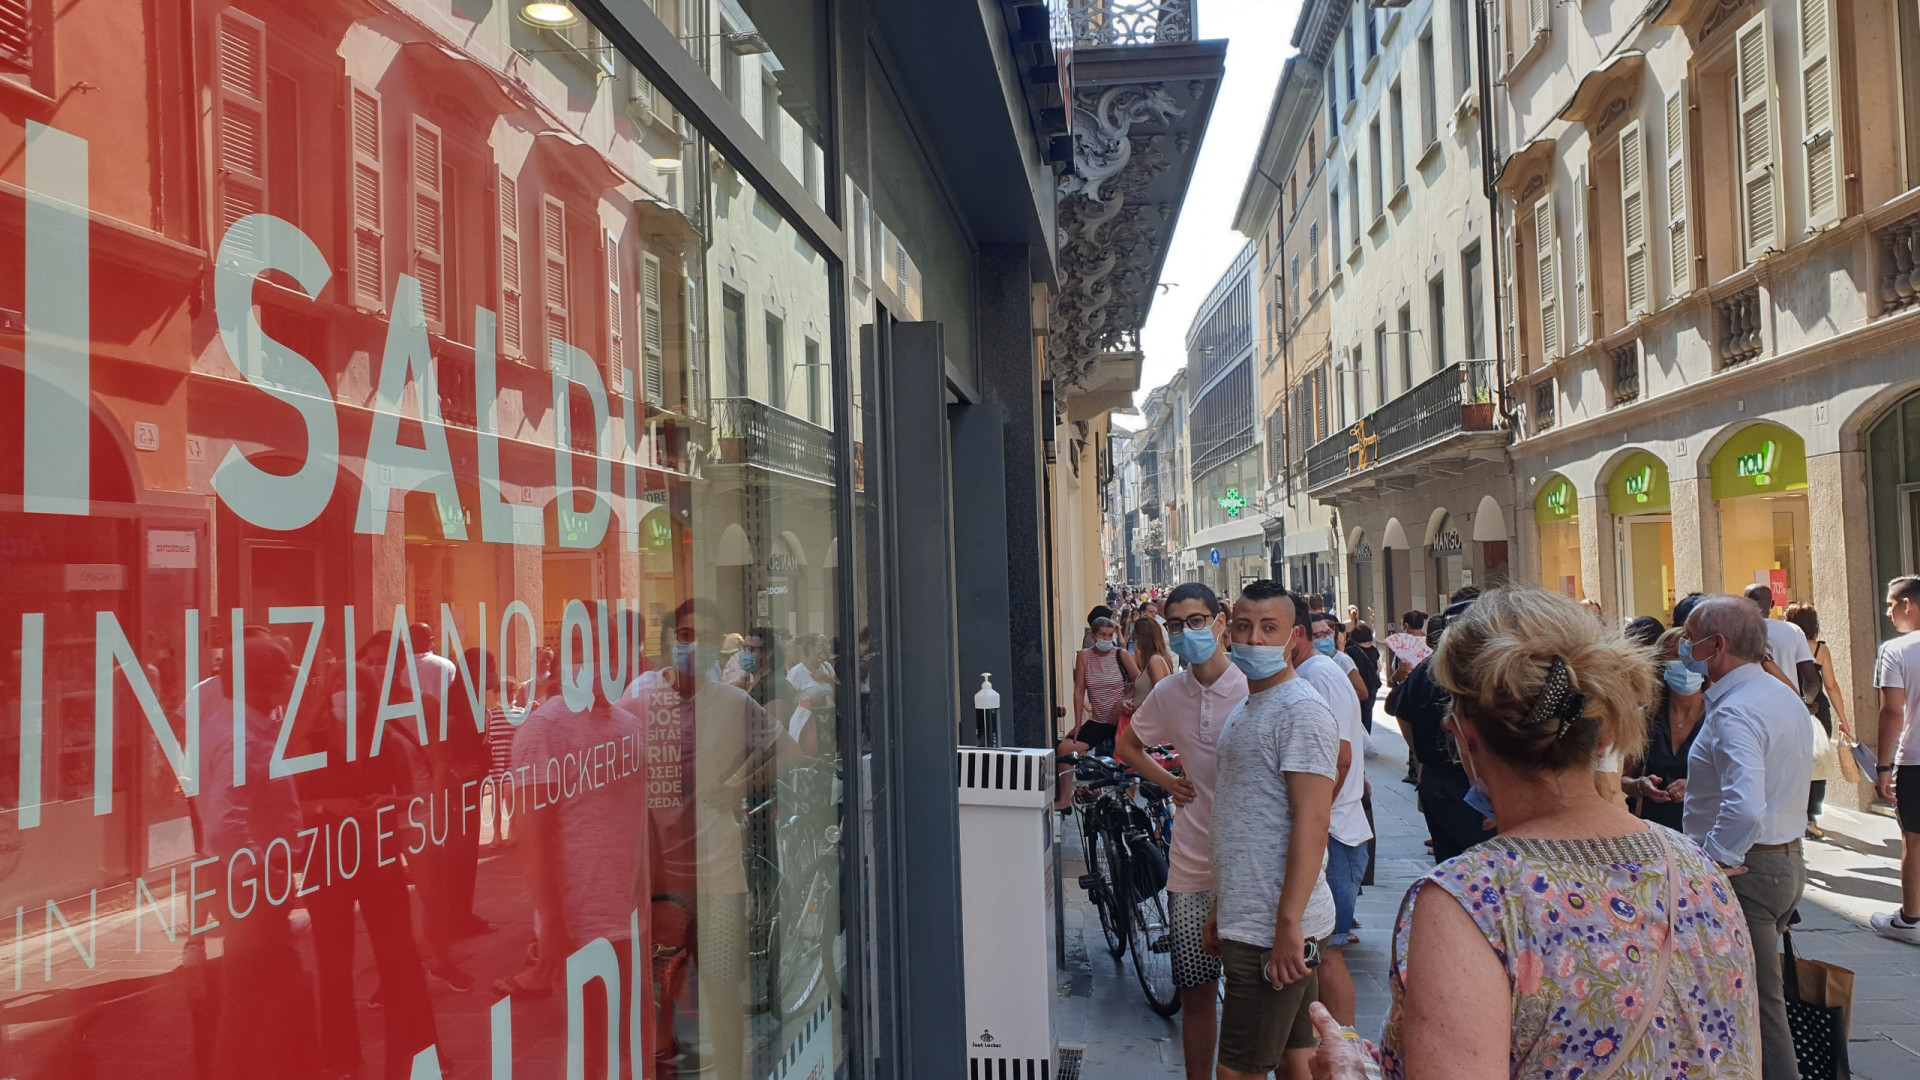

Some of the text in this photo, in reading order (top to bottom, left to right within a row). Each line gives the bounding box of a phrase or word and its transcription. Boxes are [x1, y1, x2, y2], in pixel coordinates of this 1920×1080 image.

[23, 119, 639, 552] I SALDI
[644, 490, 667, 504] ORE
[1433, 530, 1461, 552] MANGO
[1771, 581, 1787, 595] 70%
[18, 599, 640, 829] INIZIANO QUI
[15, 731, 640, 991] IN NEGOZIO E SU FOOTLOCKER.EU
